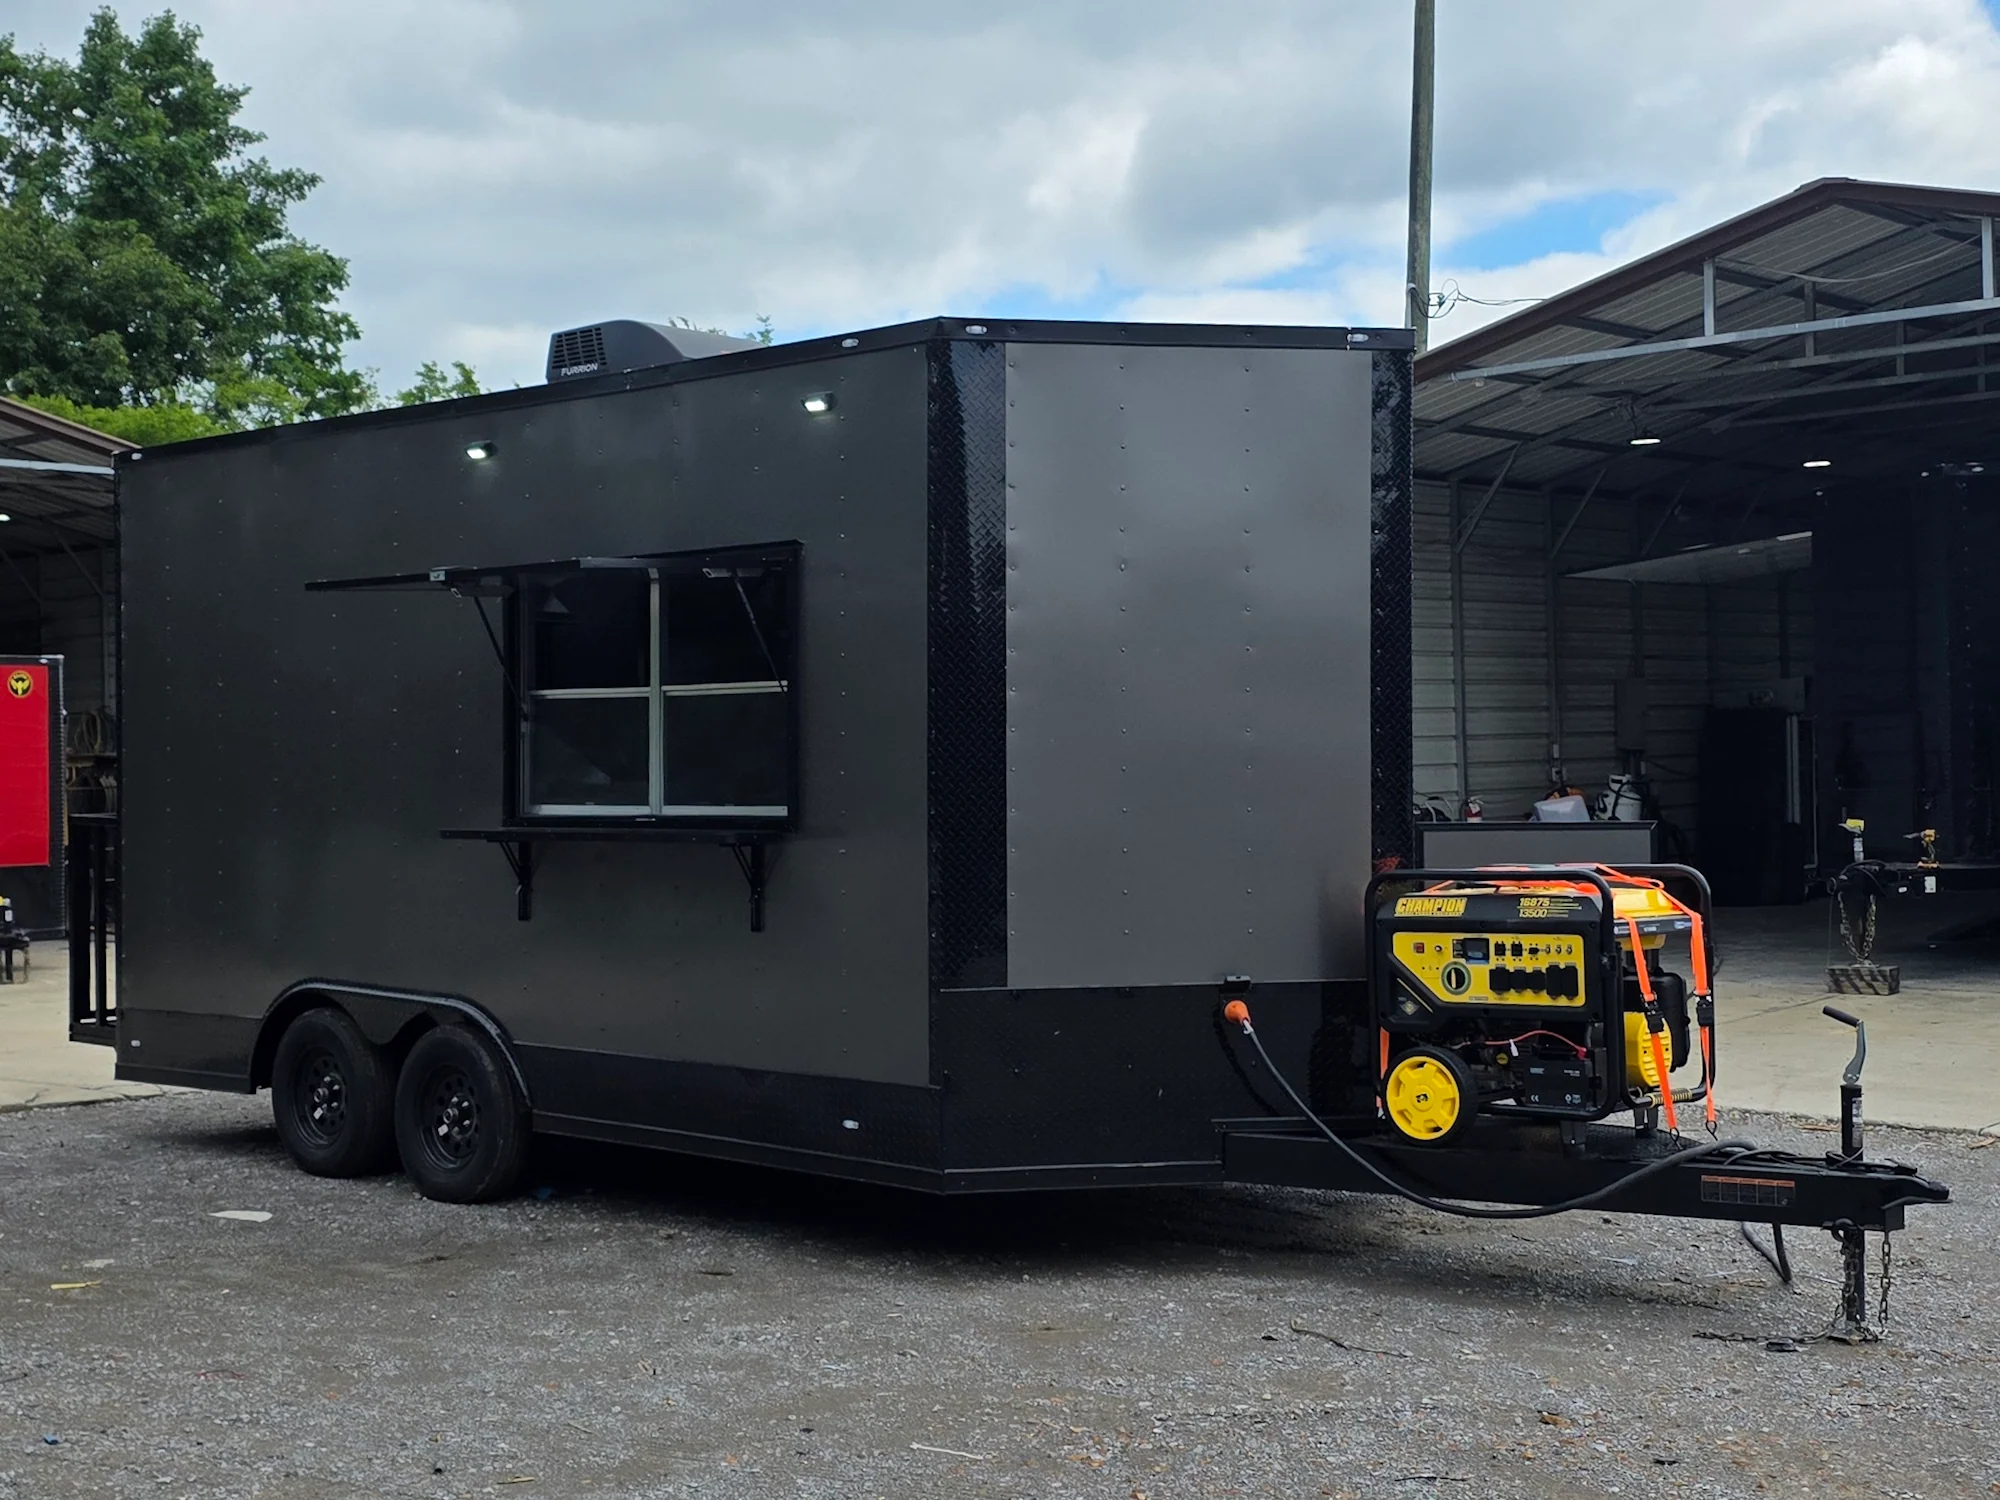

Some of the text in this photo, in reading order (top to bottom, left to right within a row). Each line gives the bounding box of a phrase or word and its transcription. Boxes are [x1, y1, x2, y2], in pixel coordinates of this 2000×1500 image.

[561, 362, 598, 376] FURRION
[1398, 898, 1466, 912] CHAMPION
[1519, 909, 1548, 918] 13500
